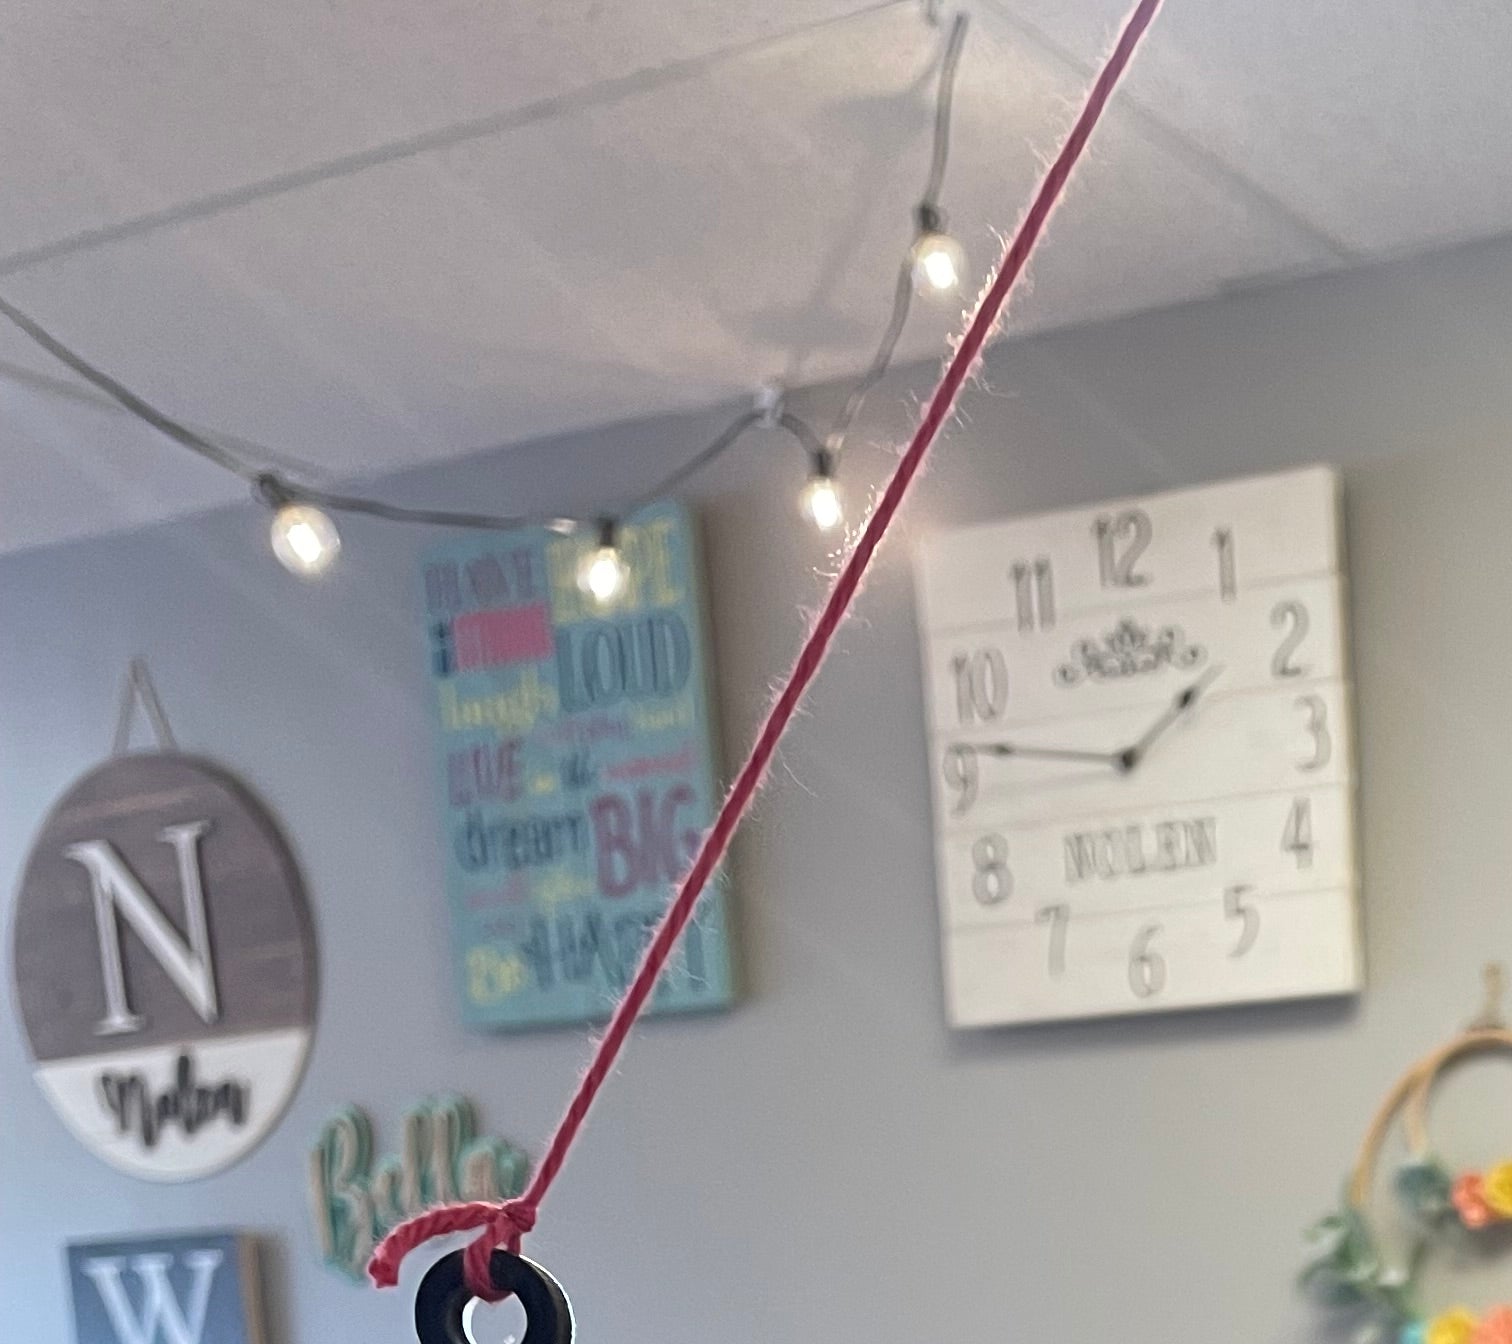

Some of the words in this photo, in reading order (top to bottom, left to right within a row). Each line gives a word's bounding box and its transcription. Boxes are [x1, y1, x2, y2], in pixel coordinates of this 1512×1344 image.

[1092, 509, 1153, 588] 12
[1212, 525, 1238, 601] 1
[1010, 554, 1056, 633] 11
[1270, 600, 1311, 679] 2
[951, 647, 1009, 725] 10
[1297, 694, 1332, 772] 3
[942, 741, 978, 818] 9
[971, 833, 1014, 906] 8
[1280, 798, 1314, 870] 4
[64, 819, 213, 1036] N
[1034, 902, 1070, 977] 7
[1222, 884, 1261, 958] 5
[1127, 923, 1167, 999] 6
